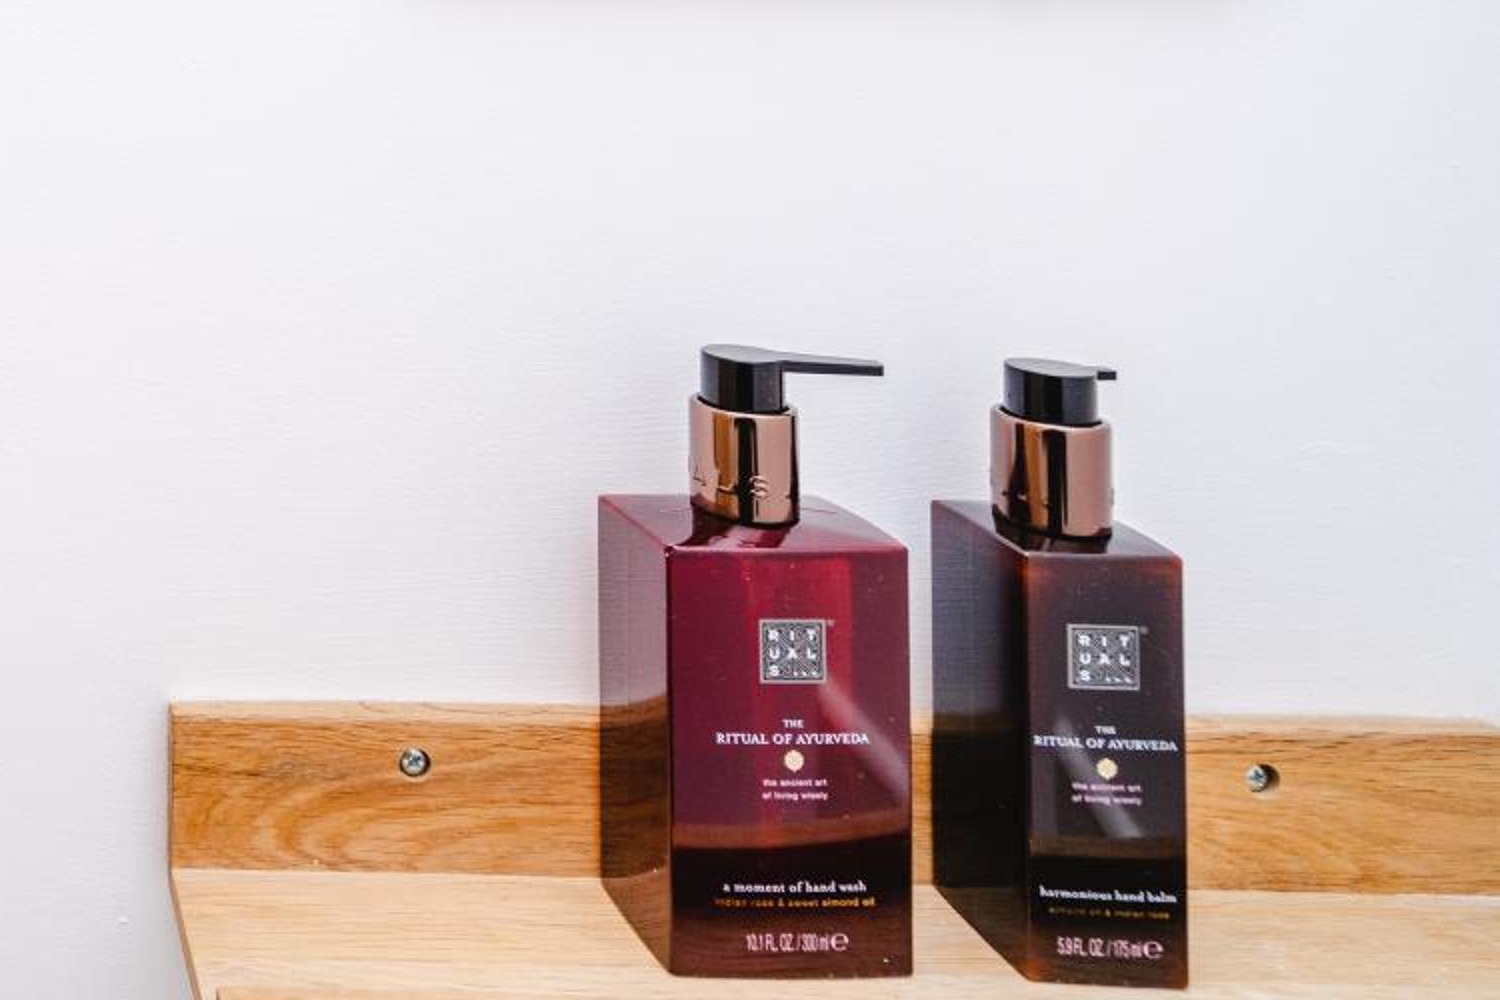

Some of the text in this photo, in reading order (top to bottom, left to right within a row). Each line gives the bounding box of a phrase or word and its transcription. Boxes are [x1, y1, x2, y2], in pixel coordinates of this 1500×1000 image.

[783, 719, 804, 728] THE
[1094, 726, 1116, 735] THE
[716, 732, 869, 744] RITUAL OF AYURVEDA
[1033, 735, 1178, 751] RITUAL OF AYURVEDA
[723, 880, 867, 893] a moment of hand wash
[1039, 884, 1178, 903] harmonious hand balm
